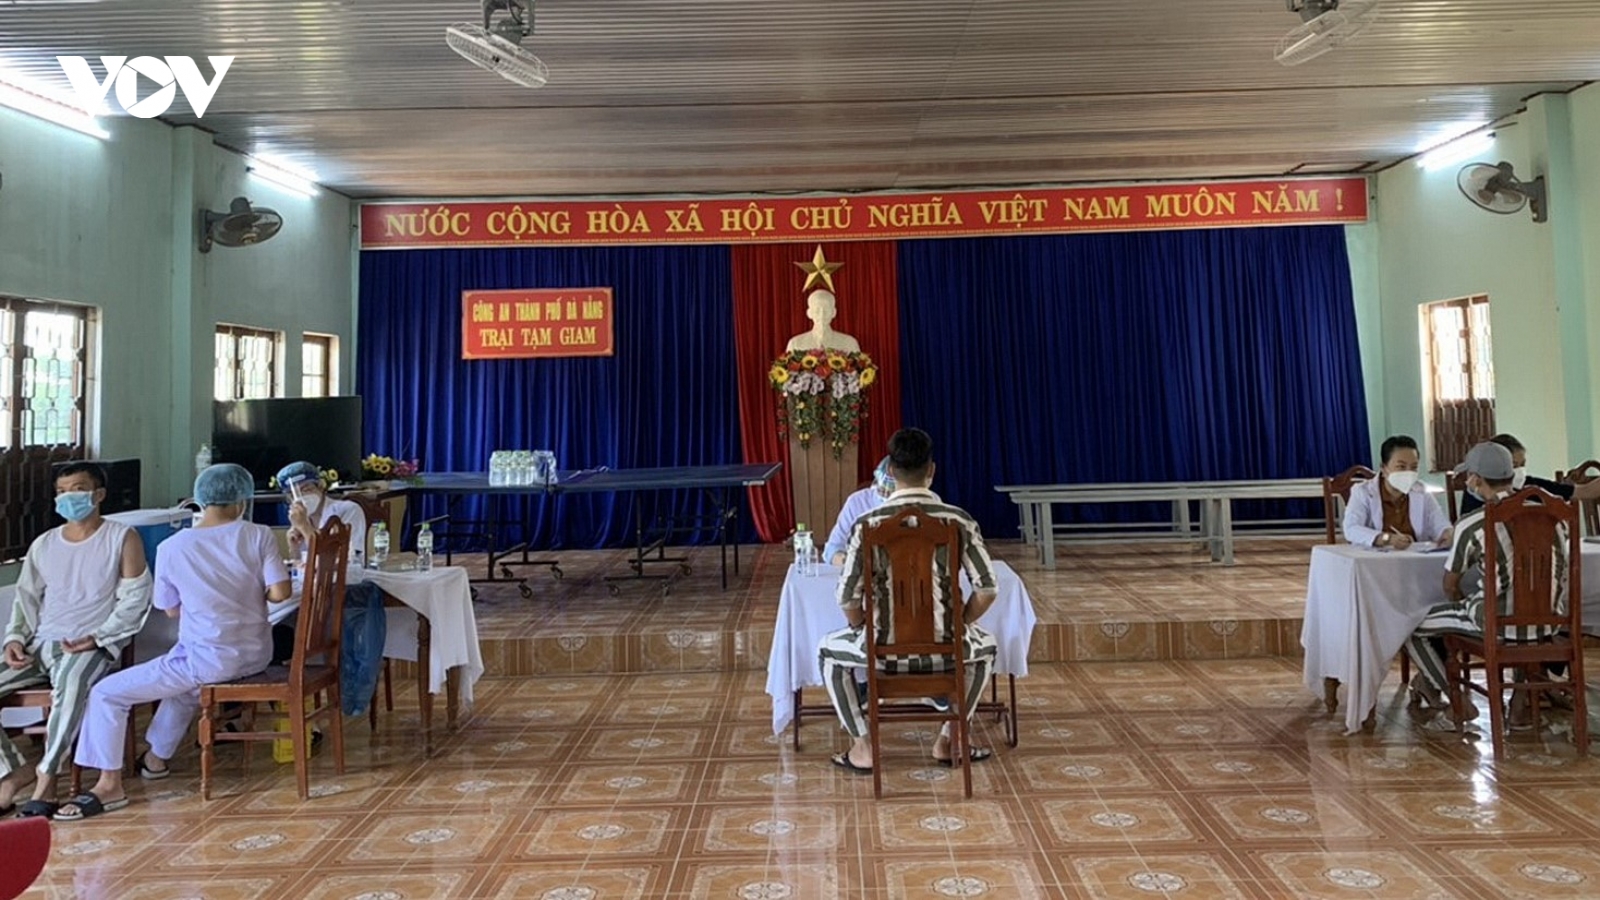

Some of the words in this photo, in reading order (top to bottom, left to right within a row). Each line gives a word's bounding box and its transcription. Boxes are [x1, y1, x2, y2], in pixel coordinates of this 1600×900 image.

[385, 205, 470, 237] NƯỚC
[486, 205, 571, 240] CỘNG
[586, 203, 651, 234] HÒA
[665, 201, 704, 233] XÃ
[720, 201, 775, 237] HỘI
[790, 198, 854, 230] CHỦ
[867, 196, 963, 228] NGHĨA
[977, 193, 1048, 229] VIỆT
[1063, 195, 1131, 220] NAM
[1145, 187, 1236, 217] MUÔN
[1251, 183, 1320, 214] NĂM
[1335, 187, 1345, 212] !
[480, 328, 514, 351] TRẠI
[521, 327, 552, 350] TẠM
[560, 326, 596, 345] GIAM
